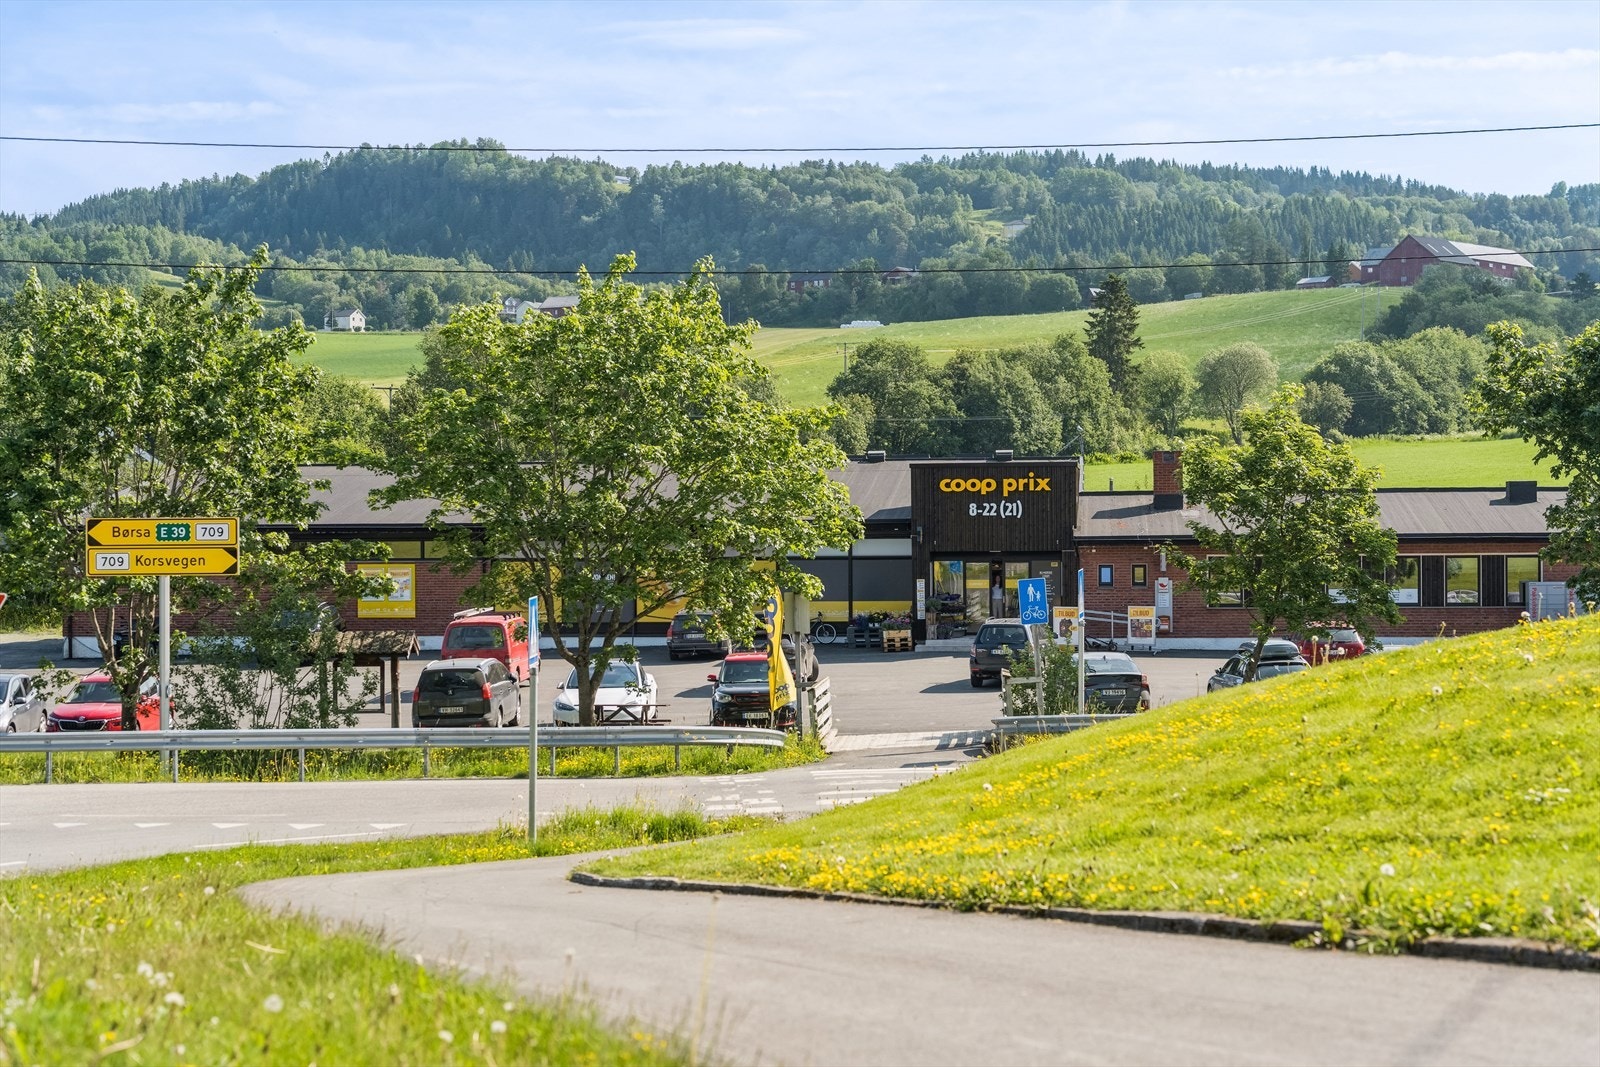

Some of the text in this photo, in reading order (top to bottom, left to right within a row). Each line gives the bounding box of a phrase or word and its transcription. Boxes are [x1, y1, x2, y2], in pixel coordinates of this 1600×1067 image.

[939, 471, 1052, 497] coop prix
[968, 500, 1023, 519] 8-22 (21)
[112, 526, 224, 538] Børsa E 39 709
[101, 555, 206, 569] 709 Korsvegen
